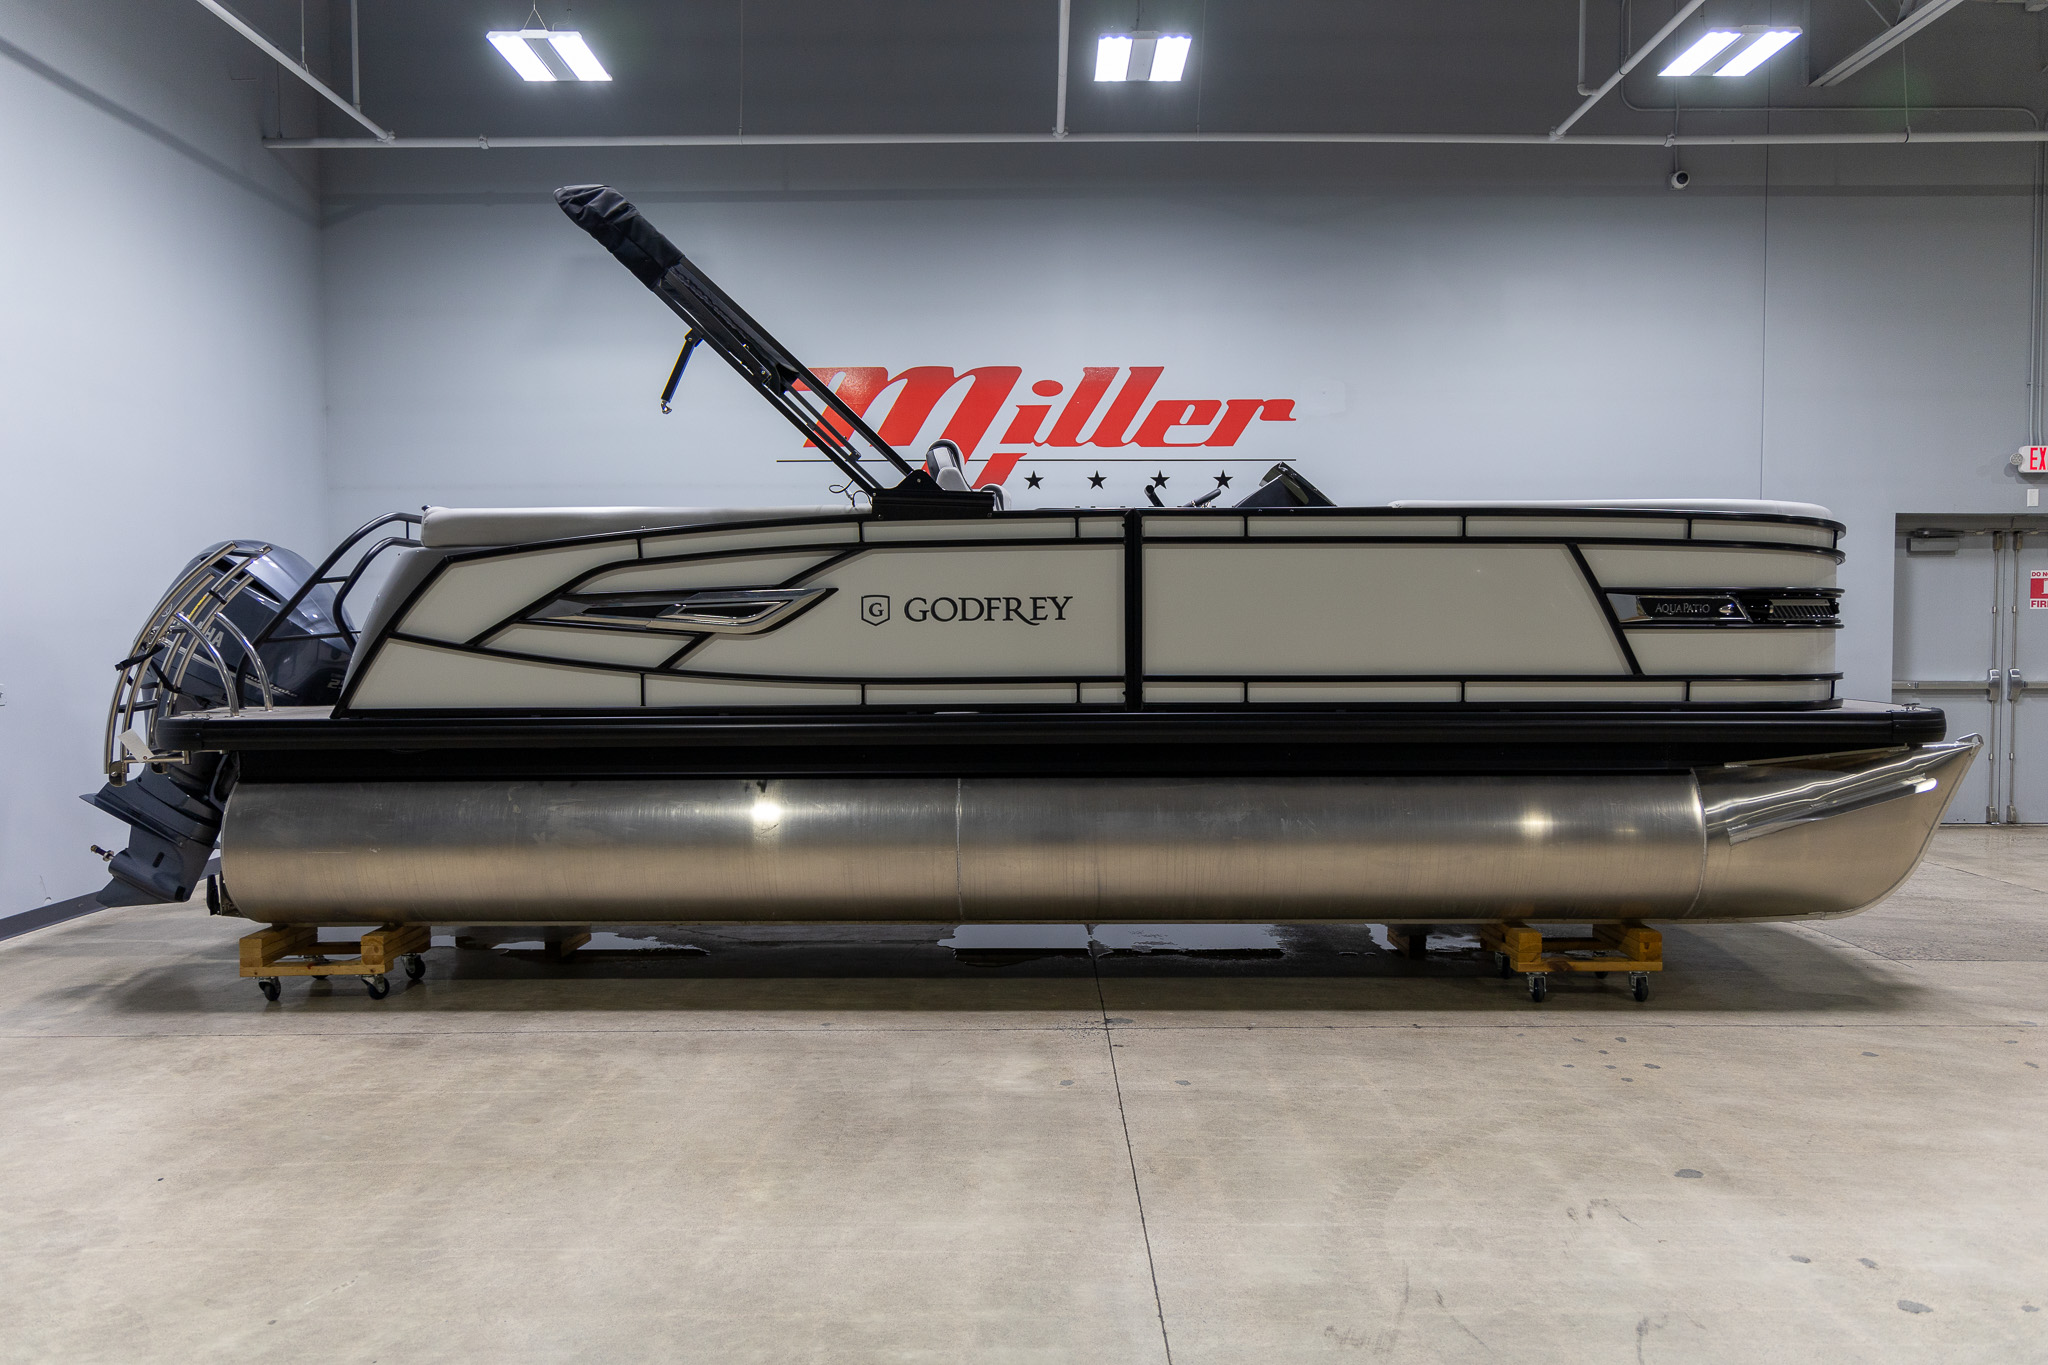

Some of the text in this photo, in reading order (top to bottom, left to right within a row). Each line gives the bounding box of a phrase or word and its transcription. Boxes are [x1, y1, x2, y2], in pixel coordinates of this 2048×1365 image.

[791, 366, 1296, 490] Miller
[2030, 447, 2048, 471] EX
[868, 596, 1073, 626] G GODFREY
[2031, 600, 2048, 608] FIR
